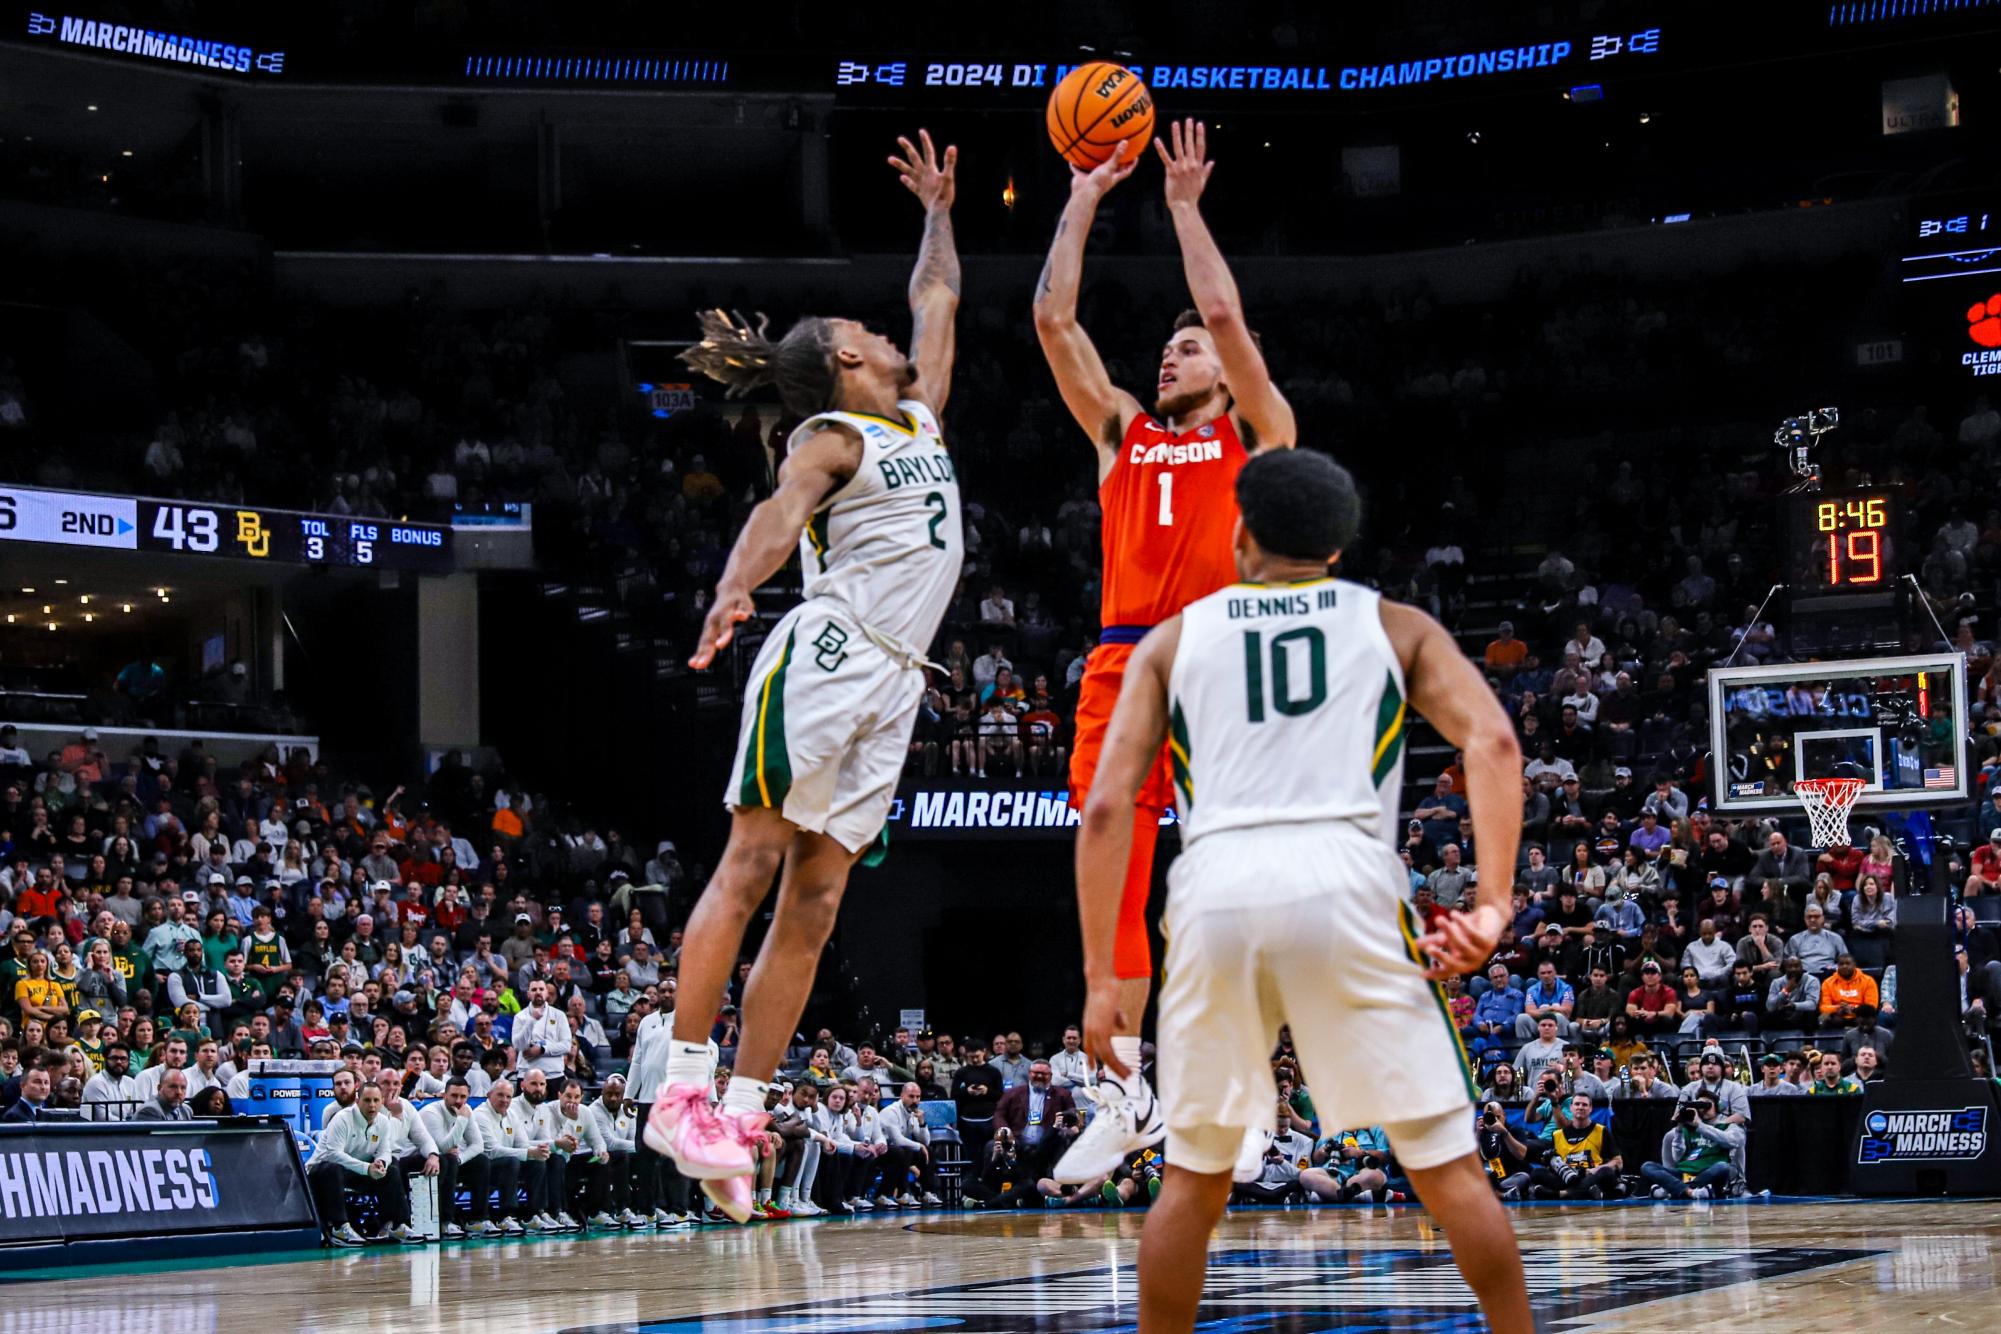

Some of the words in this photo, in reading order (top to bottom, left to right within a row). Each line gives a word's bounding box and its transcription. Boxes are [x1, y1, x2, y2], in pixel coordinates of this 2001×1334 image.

[60, 15, 253, 73] MARCHMADNESS
[925, 64, 1003, 87] 2024
[1012, 64, 1046, 87] DI
[1151, 65, 1331, 89] BASKETBALL
[1339, 40, 1572, 89] CHAMPIONSHIP
[653, 392, 692, 409] 103A
[877, 454, 957, 490] BAYLO
[1157, 472, 1174, 526] 1
[1818, 499, 1887, 531] 8:46
[61, 510, 115, 537] 2ND
[153, 506, 219, 553] 43
[301, 519, 330, 537] TOL
[351, 524, 378, 541] FLS
[391, 527, 443, 546] BONUS
[924, 491, 948, 550] 2
[307, 536, 324, 560] 3
[356, 540, 373, 564] 5
[1829, 531, 1880, 585] 19
[1227, 593, 1310, 620] DENNIS
[1317, 589, 1337, 611] III
[1243, 625, 1328, 723] 10
[1887, 1114, 1952, 1133] MARCH
[1895, 1132, 1983, 1152] MADNESS
